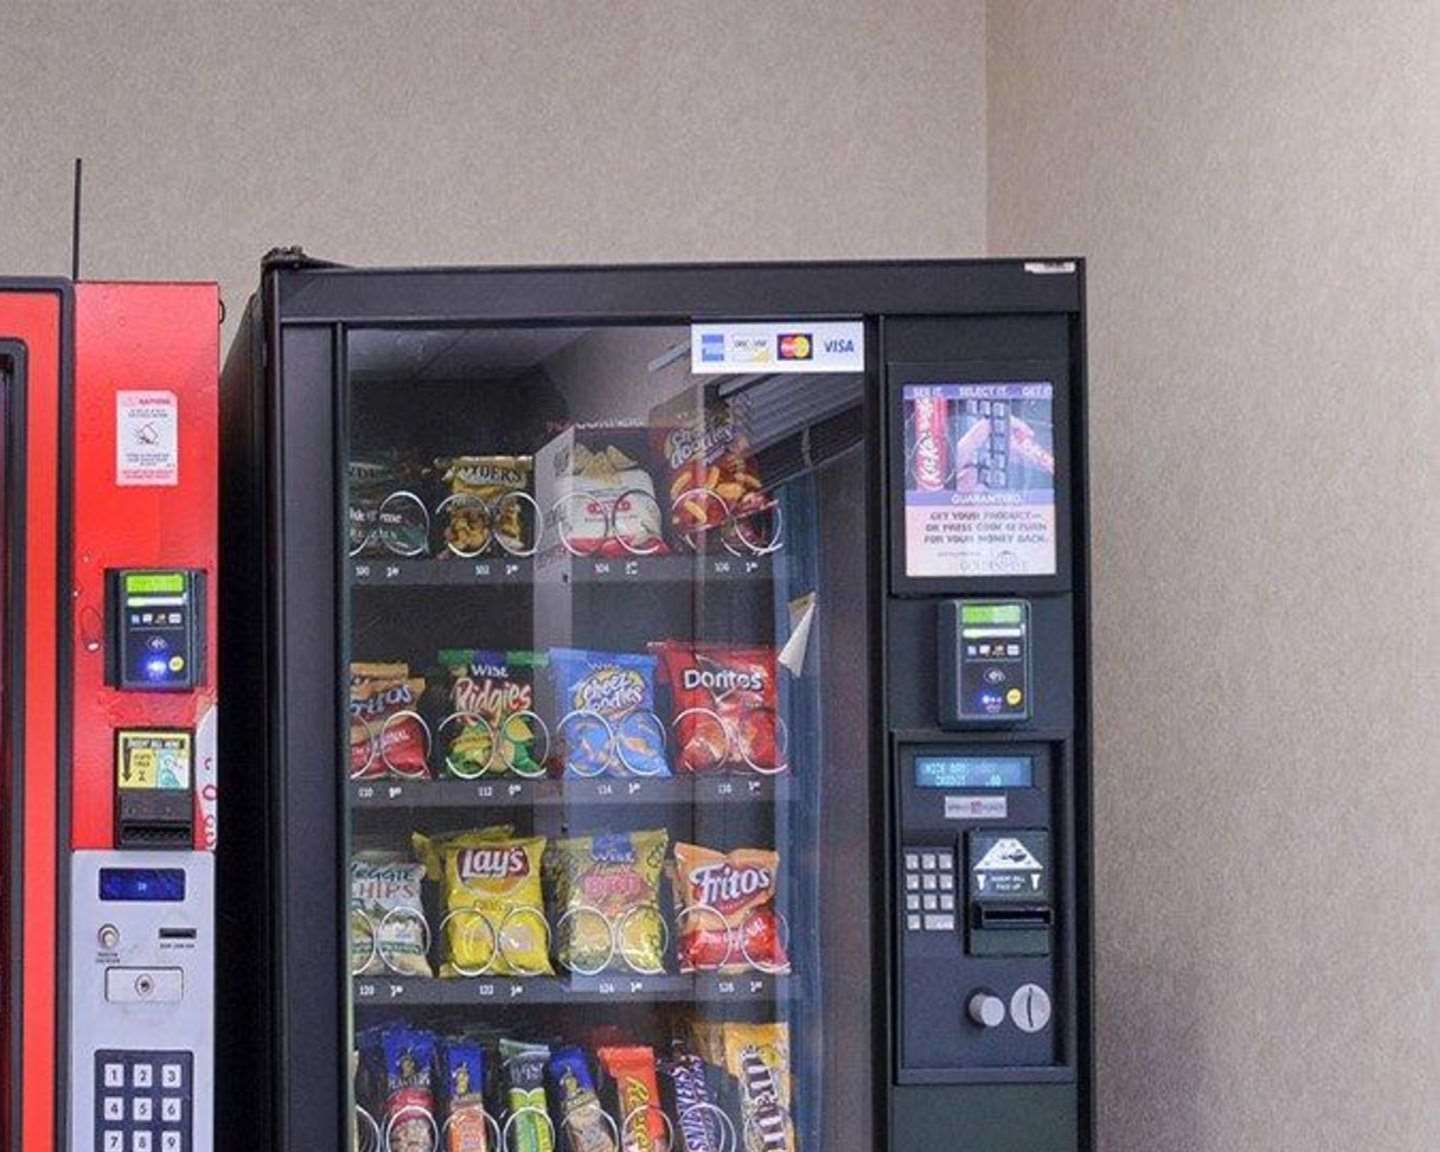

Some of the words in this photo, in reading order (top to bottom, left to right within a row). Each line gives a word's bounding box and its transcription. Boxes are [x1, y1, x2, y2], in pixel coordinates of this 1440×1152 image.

[824, 340, 855, 354] VISA
[684, 667, 765, 692] Doritos
[456, 678, 532, 728] Ridgies
[462, 846, 525, 880] Lay's
[691, 861, 771, 904] Fritos
[111, 1069, 118, 1081] 1
[139, 1070, 147, 1081] 2
[168, 1070, 176, 1082] 3
[110, 1103, 119, 1114] 4
[139, 1103, 147, 1114] 5
[168, 1103, 176, 1115] 6
[110, 1136, 119, 1149] 7
[139, 1137, 147, 1148] 8
[168, 1137, 176, 1148] 9
